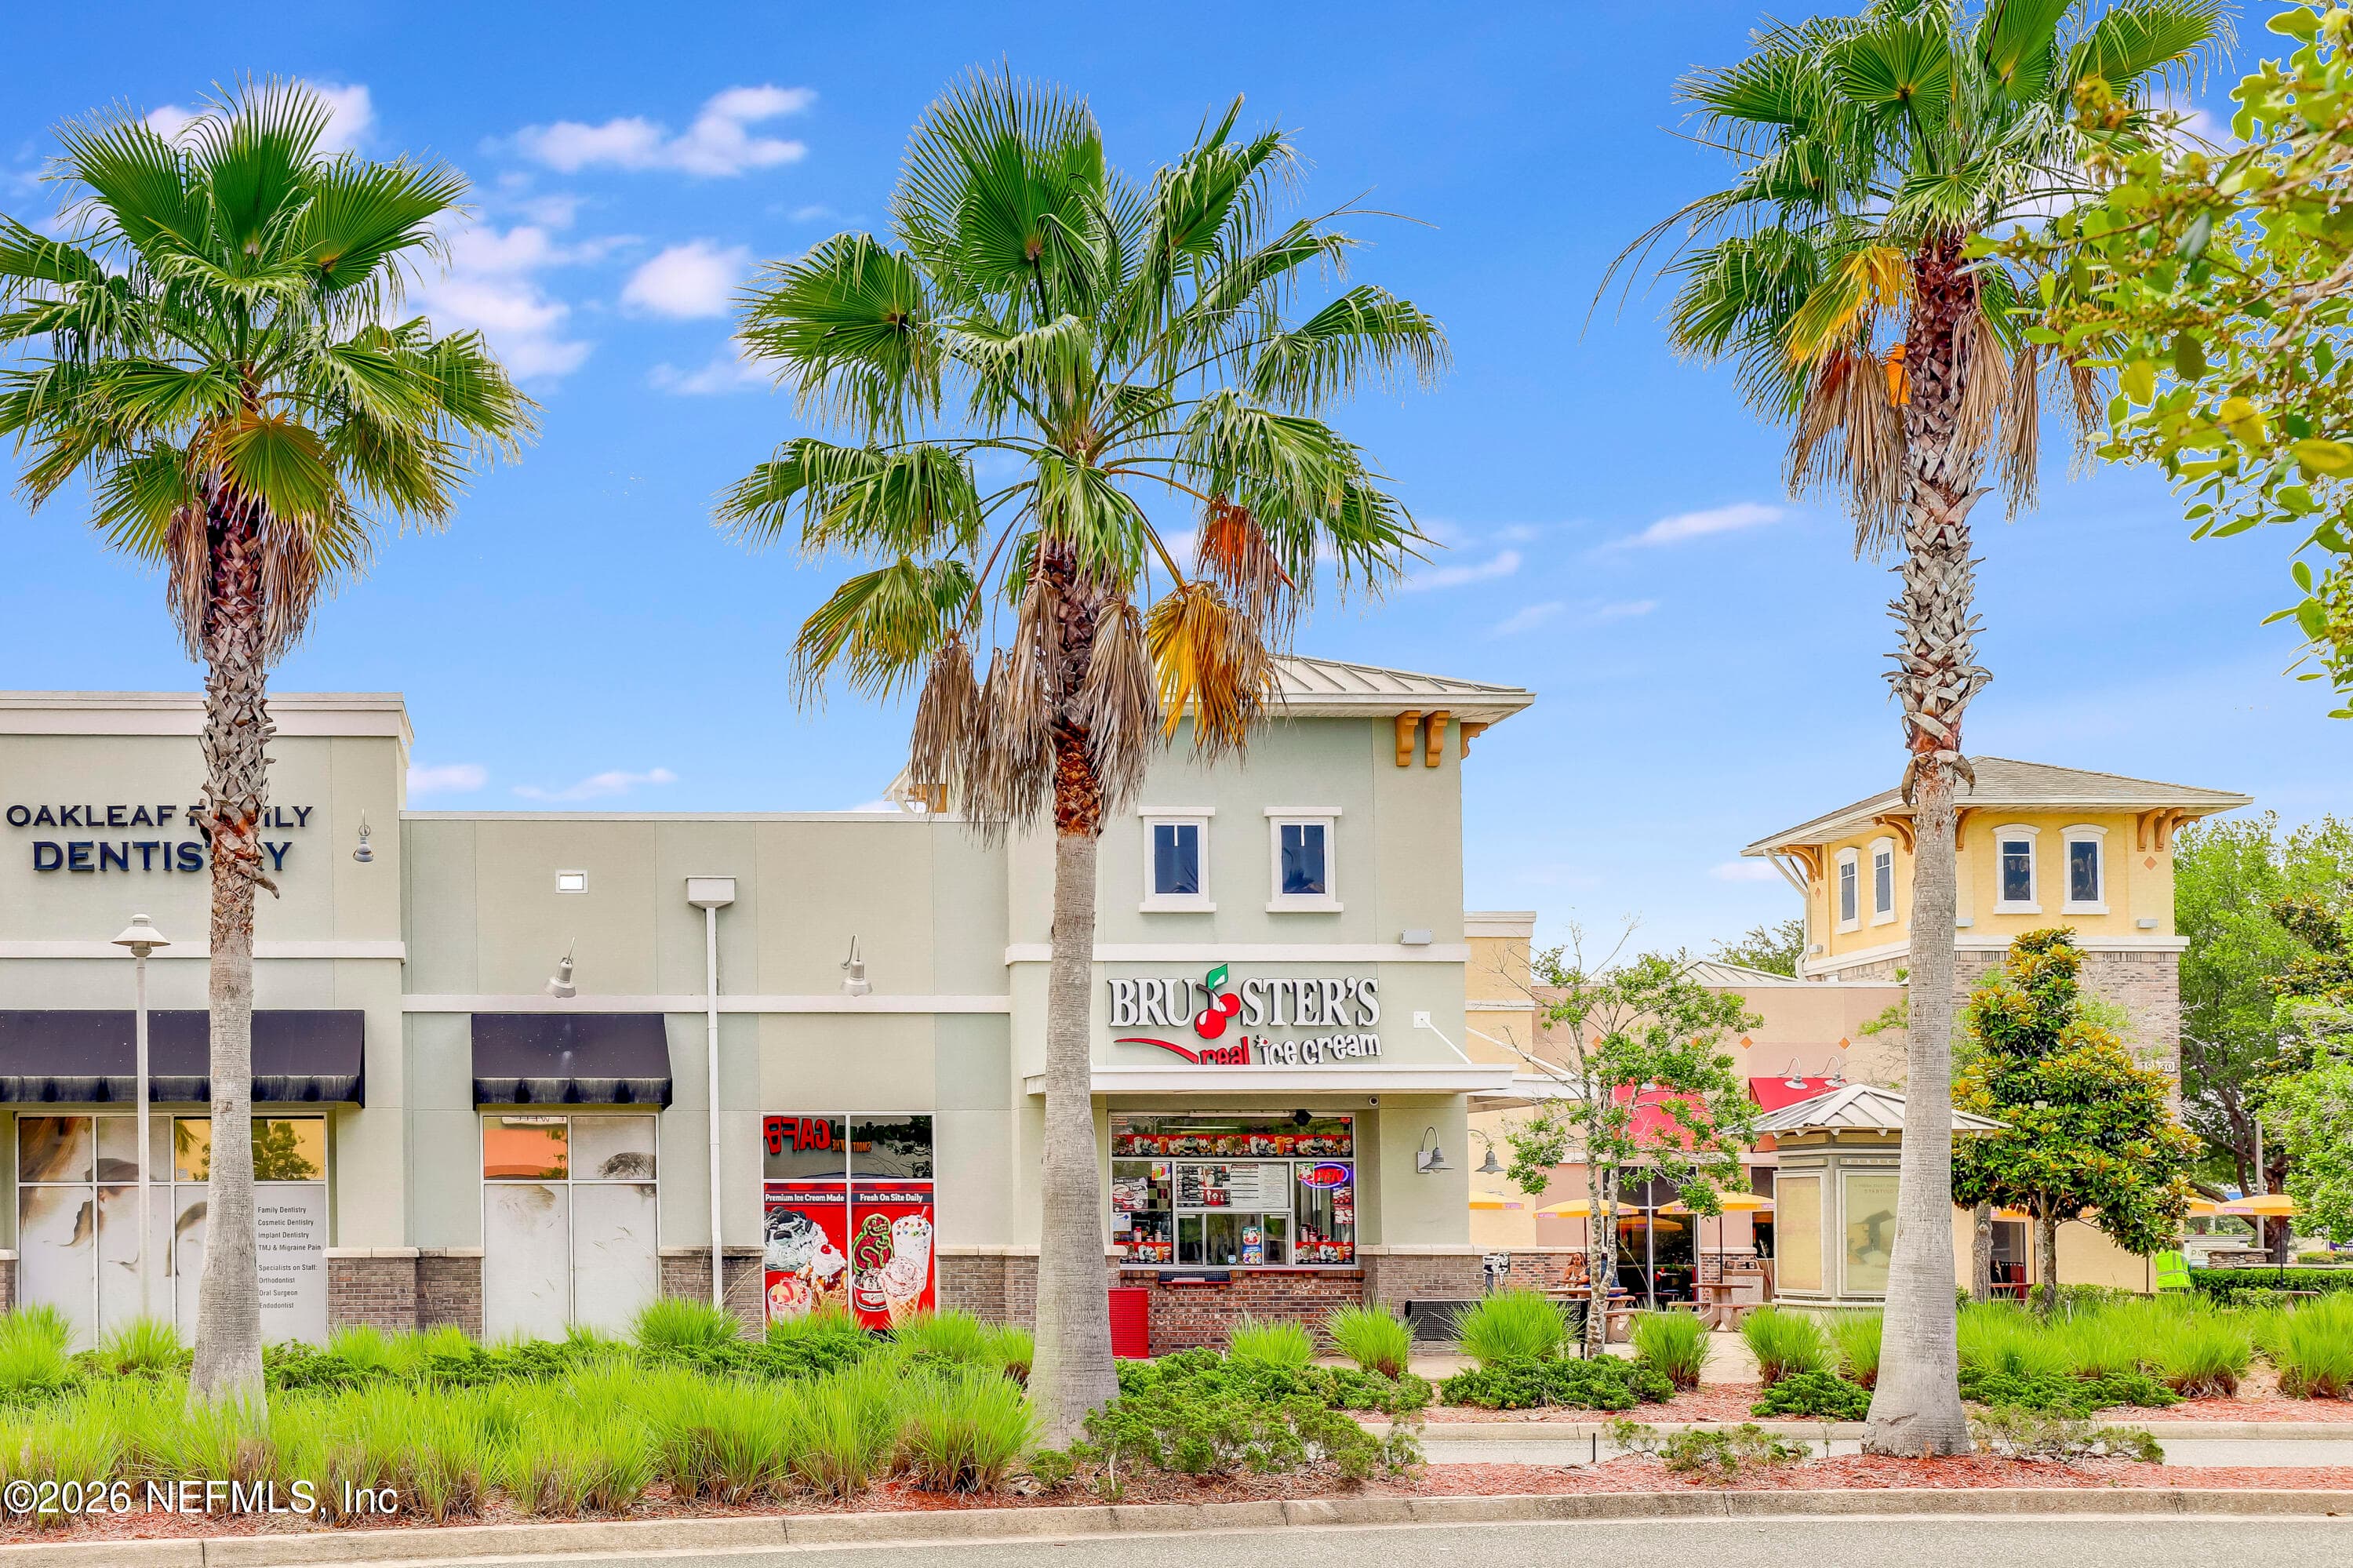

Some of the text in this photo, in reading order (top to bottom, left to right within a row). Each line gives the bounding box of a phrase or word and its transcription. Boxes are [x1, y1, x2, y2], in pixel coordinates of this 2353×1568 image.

[6, 805, 314, 827] OAKLEAF FILY
[32, 840, 293, 872] DENTISY
[1201, 1033, 1383, 1065] real ice cream
[1314, 1167, 1344, 1184] PEN
[765, 1193, 845, 1202] Premium Ice Cream Made
[860, 1193, 923, 1203] Fresh On Site Daily
